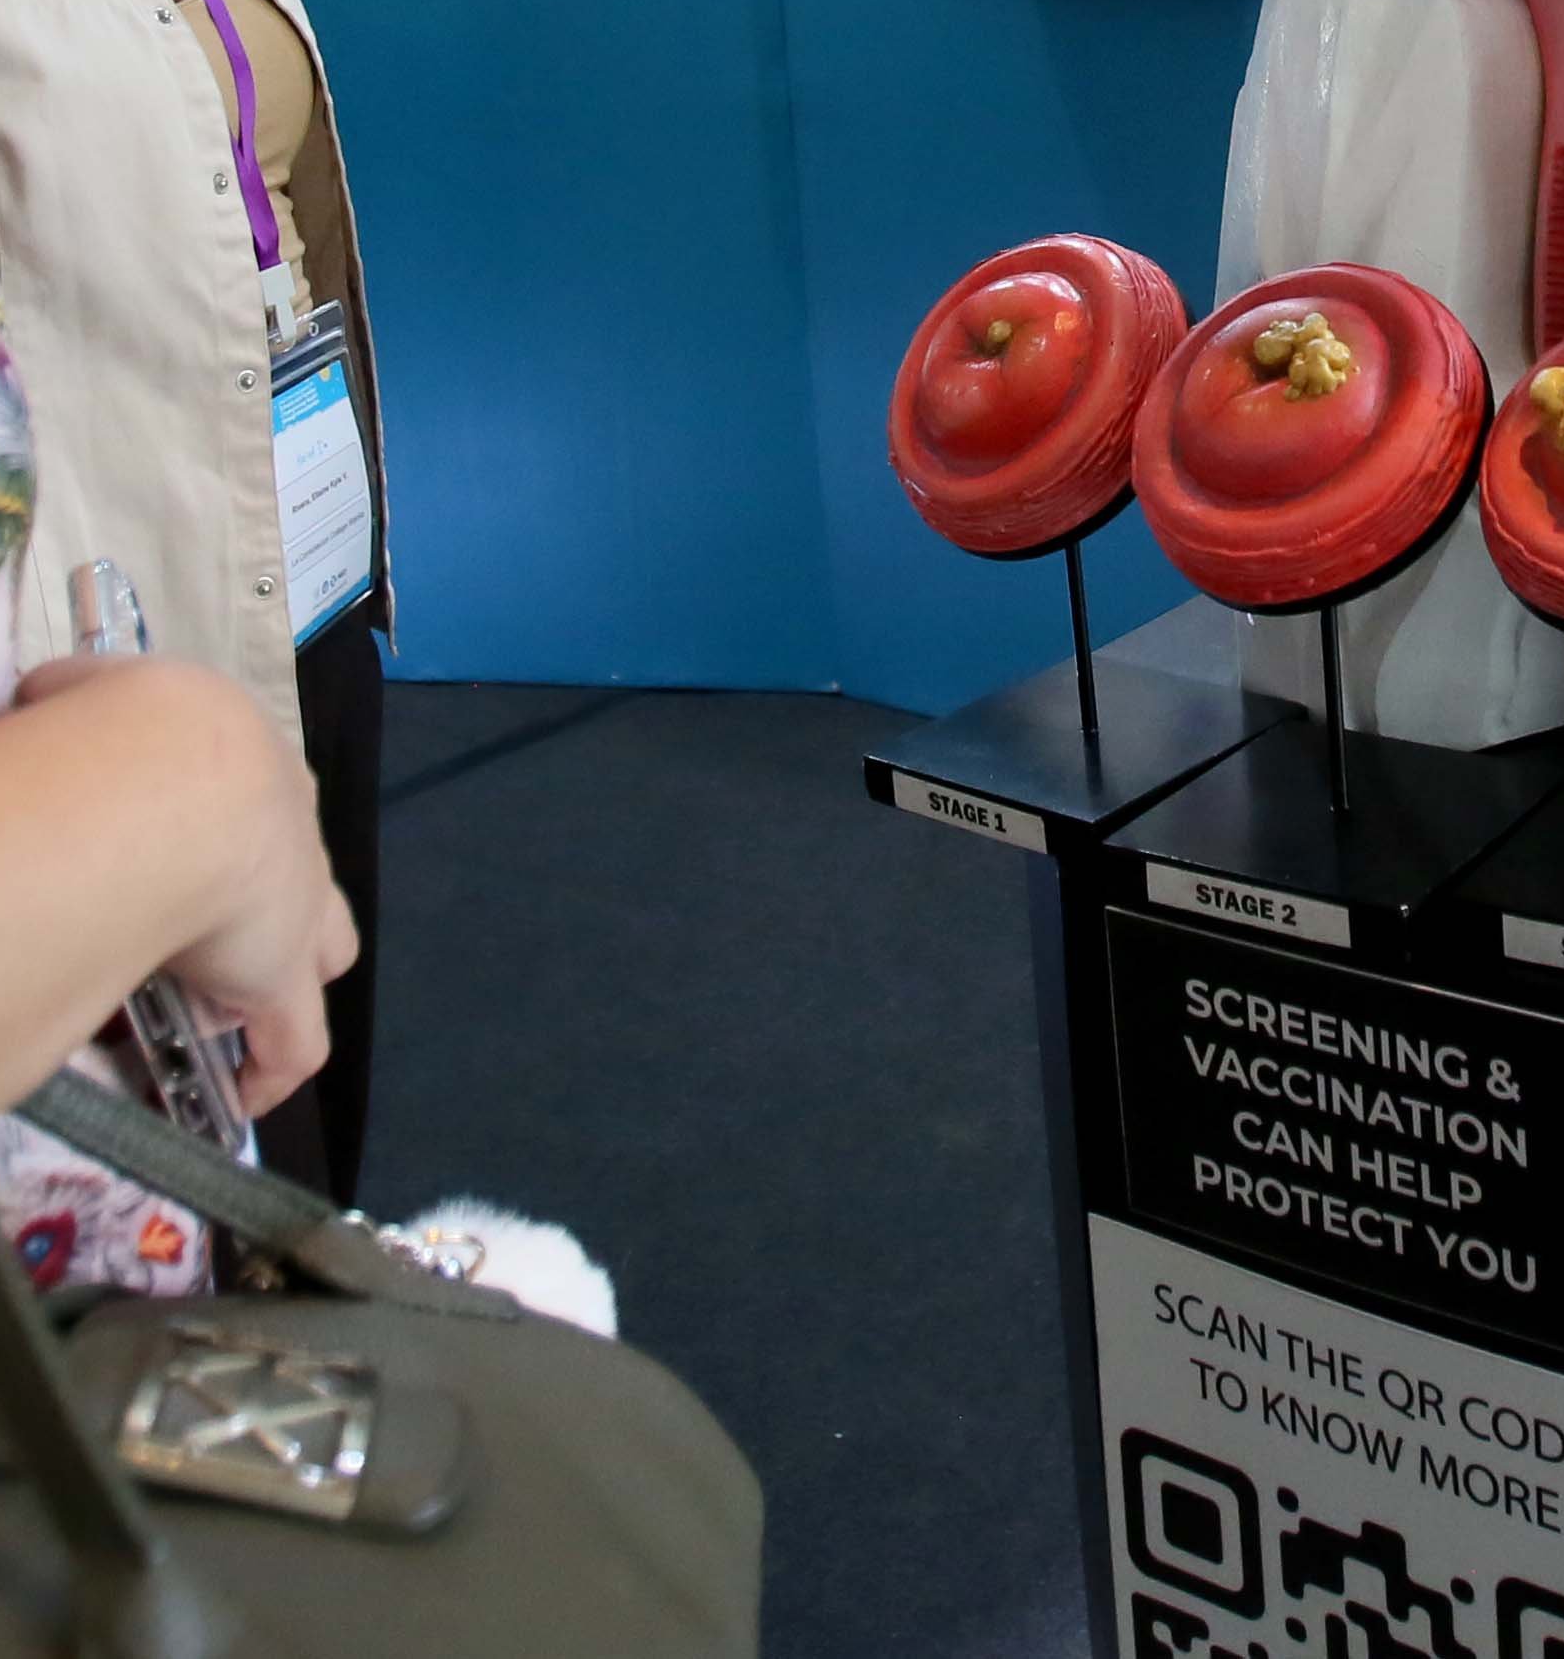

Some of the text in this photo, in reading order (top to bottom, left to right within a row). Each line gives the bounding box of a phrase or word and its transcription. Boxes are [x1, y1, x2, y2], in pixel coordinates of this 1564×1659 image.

[927, 791, 1007, 834] STAGE 1
[1195, 883, 1297, 927] STAGE 2
[1183, 1035, 1528, 1168] VACCINATION
[1185, 978, 1521, 1103] SCREENING &
[1193, 1154, 1537, 1293] PROTECT YOU
[1232, 1111, 1482, 1211] CAN HELP
[1154, 1283, 1268, 1362] SCAN
[1276, 1329, 1366, 1398] THE
[1378, 1368, 1446, 1427] QR
[1189, 1357, 1561, 1534] TO KNOW MORE
